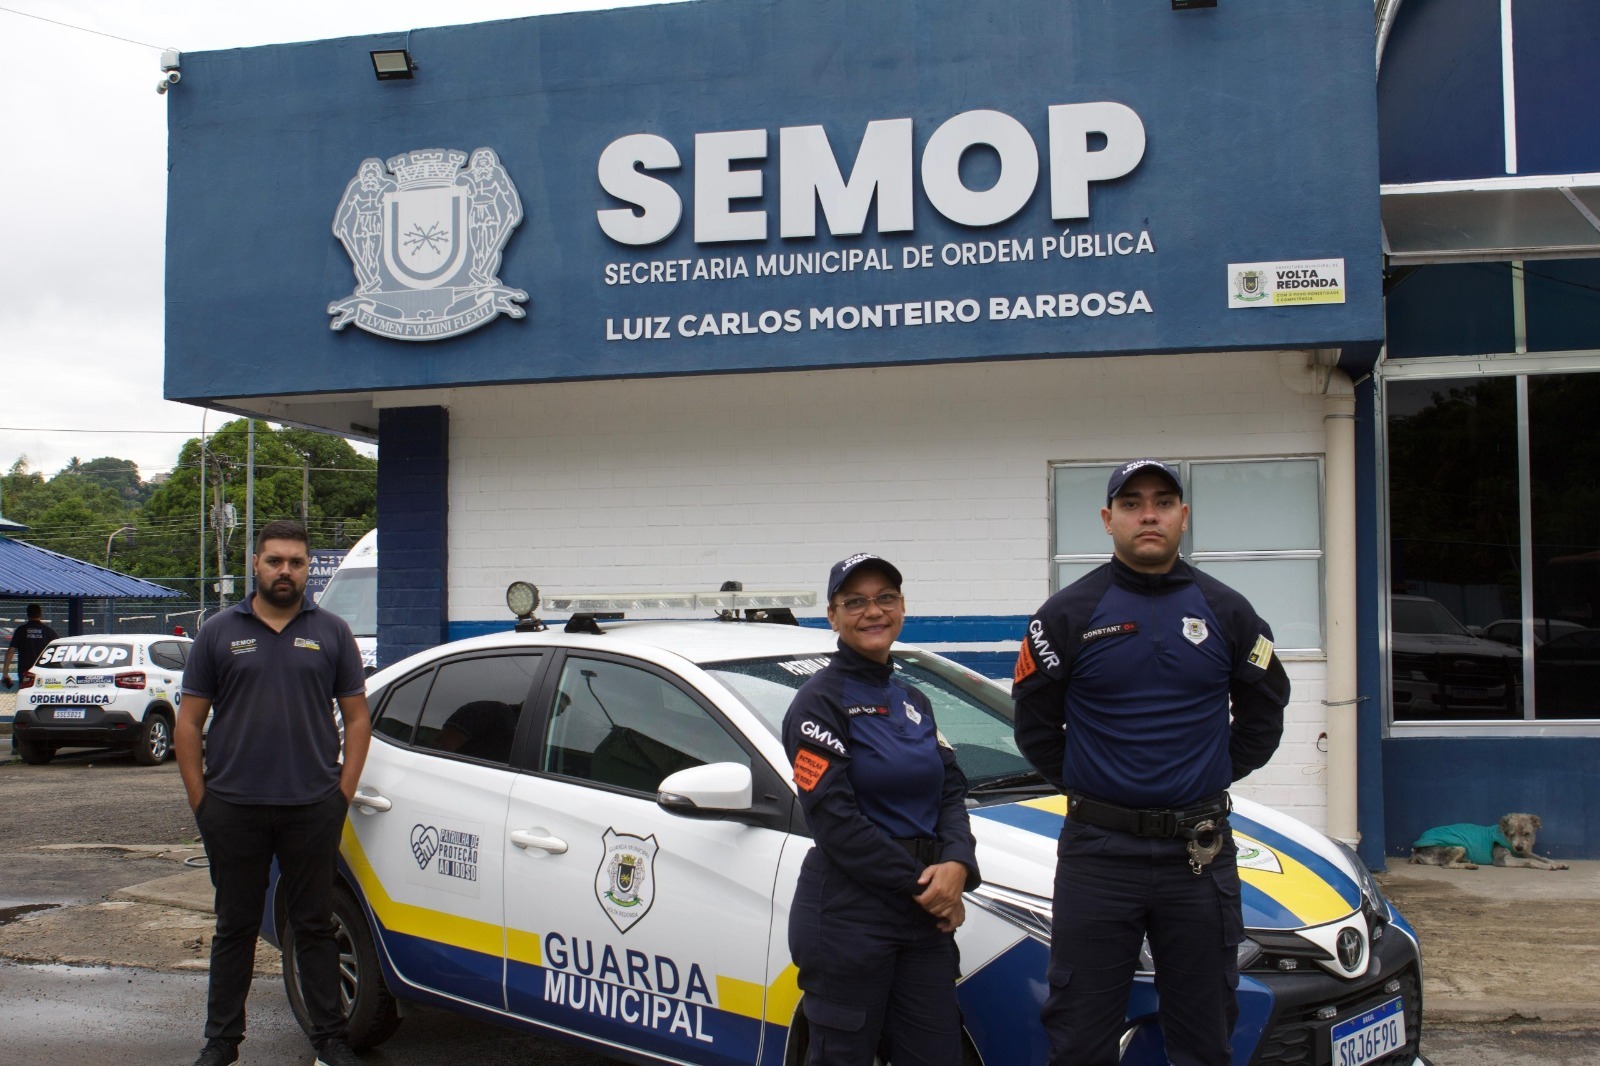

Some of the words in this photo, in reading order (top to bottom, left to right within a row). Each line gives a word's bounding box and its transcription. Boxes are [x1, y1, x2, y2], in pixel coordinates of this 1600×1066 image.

[597, 101, 1147, 246] SEMOP
[604, 257, 749, 286] SECRETARIA
[756, 248, 893, 277] MUNICIPAL
[903, 245, 934, 269] DE
[941, 238, 1034, 266] ORDEM
[1042, 228, 1154, 260] PÚBLICA
[1276, 270, 1318, 279] VOLTA
[1276, 278, 1338, 289] REDONDA
[454, 303, 490, 329] FLEXIT
[606, 316, 671, 341] LUIZ
[678, 309, 802, 338] CARLOS
[809, 299, 981, 331] MONTEIRO
[989, 290, 1153, 321] BARBOSA
[39, 645, 128, 665] SEMOP
[231, 638, 256, 646] SEMOP
[1030, 620, 1060, 670] GMVR
[30, 694, 64, 704] ORDEM
[66, 692, 110, 704] PÚBLICA
[801, 721, 846, 754] GMVR
[441, 829, 470, 847] PATRULHA
[471, 835, 479, 848] DE
[439, 859, 450, 875] AO
[452, 861, 476, 881] IDOSO
[545, 932, 713, 1004] GUARDA
[544, 970, 713, 1043] MUNICIPAL
